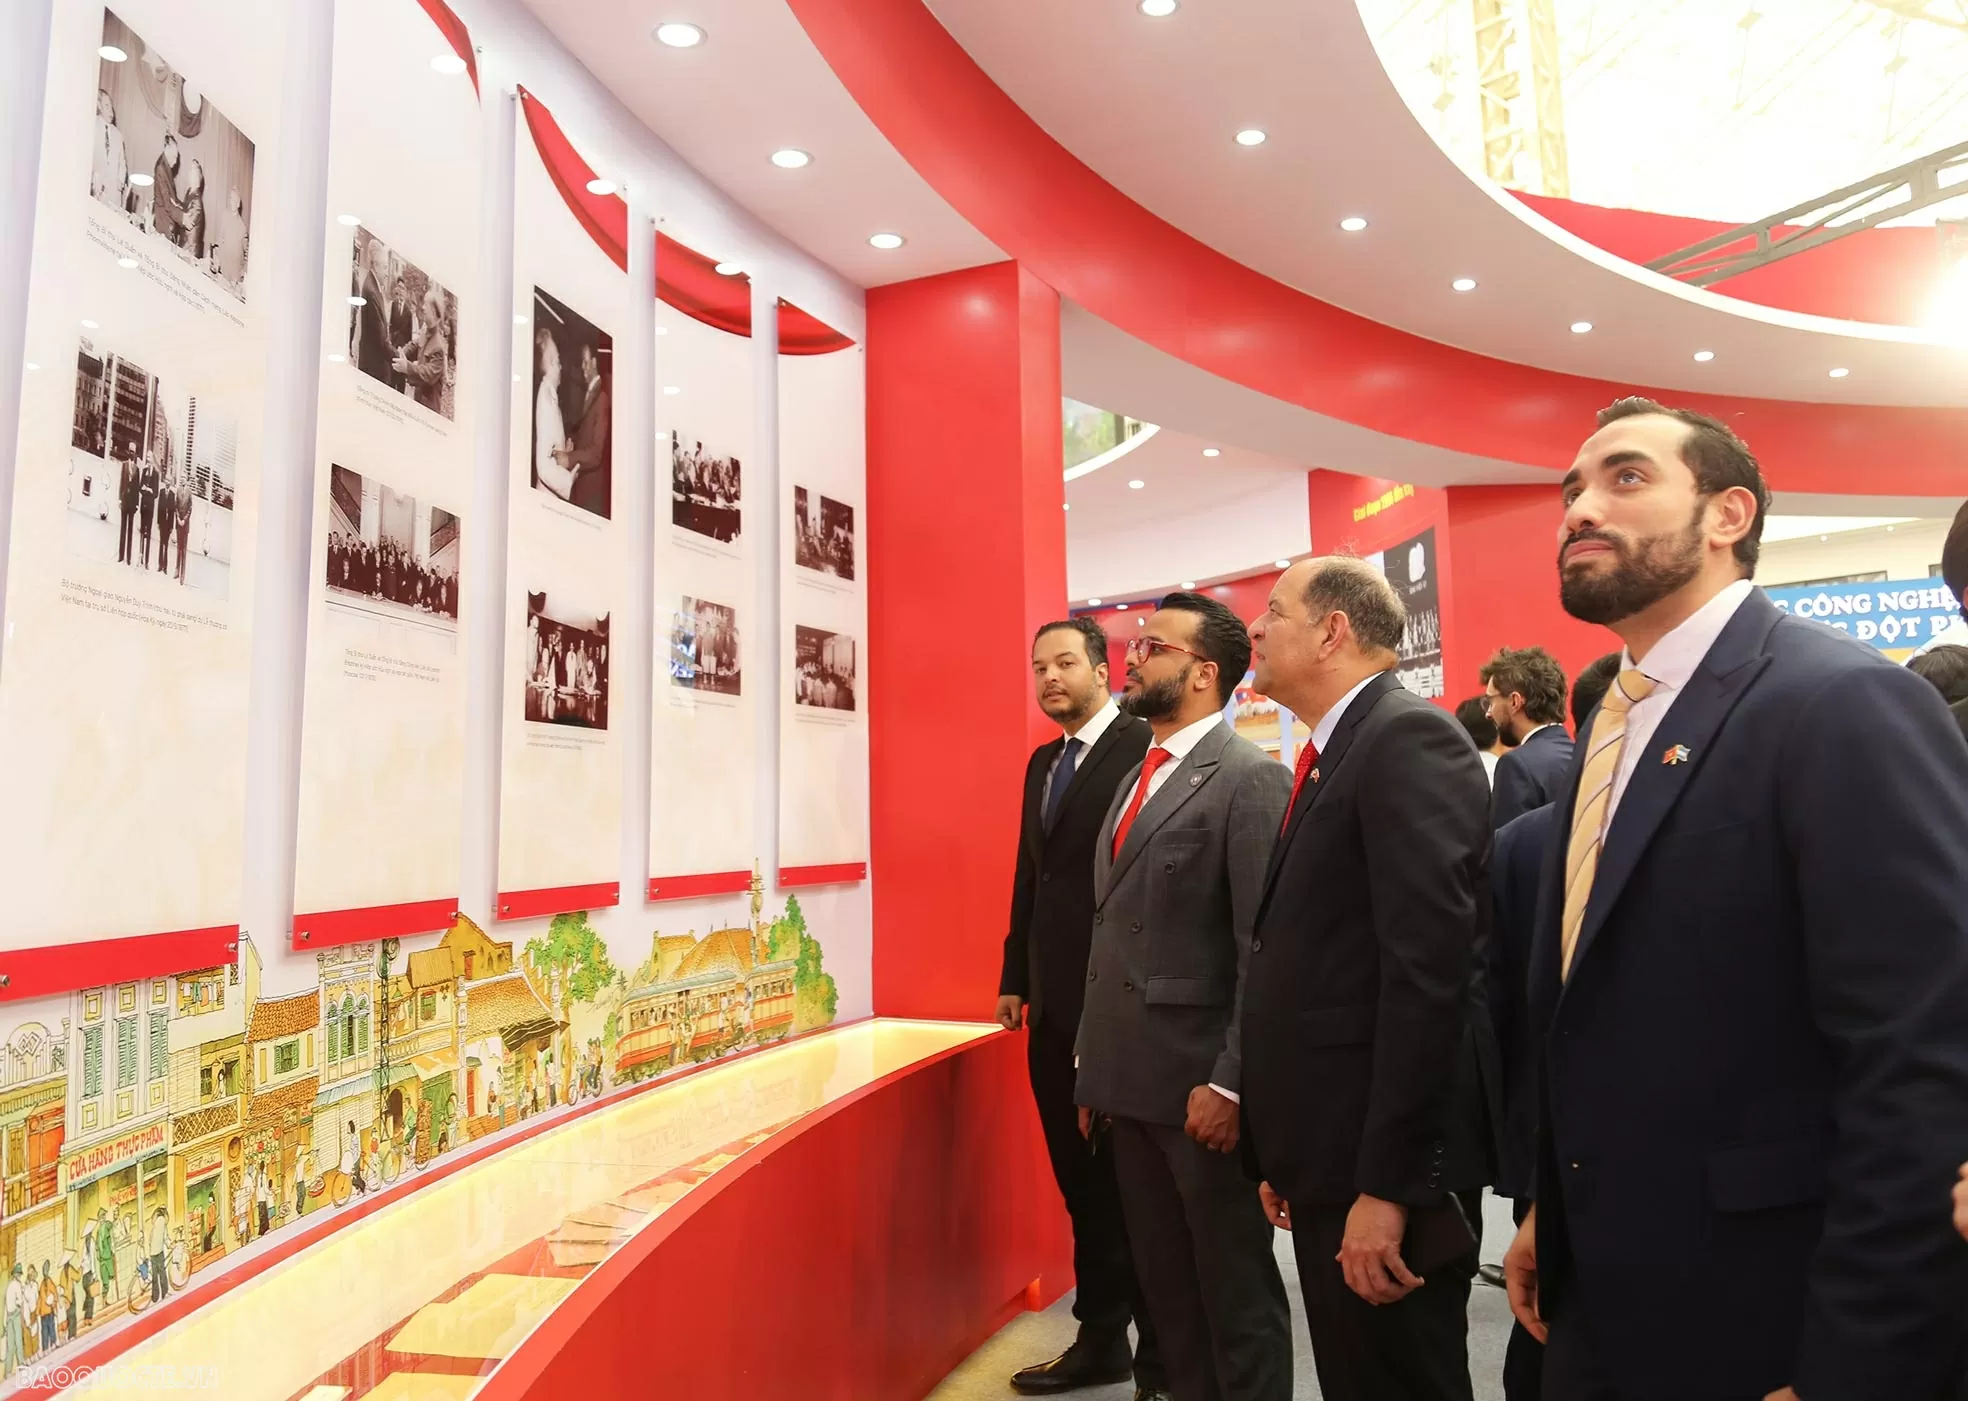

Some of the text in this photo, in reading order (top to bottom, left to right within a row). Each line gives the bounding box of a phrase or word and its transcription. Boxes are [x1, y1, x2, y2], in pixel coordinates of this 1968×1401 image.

[1795, 592, 1872, 618] CÔNG
[1877, 584, 1961, 612] NGHỆ
[1857, 615, 1921, 644] ĐỘT
